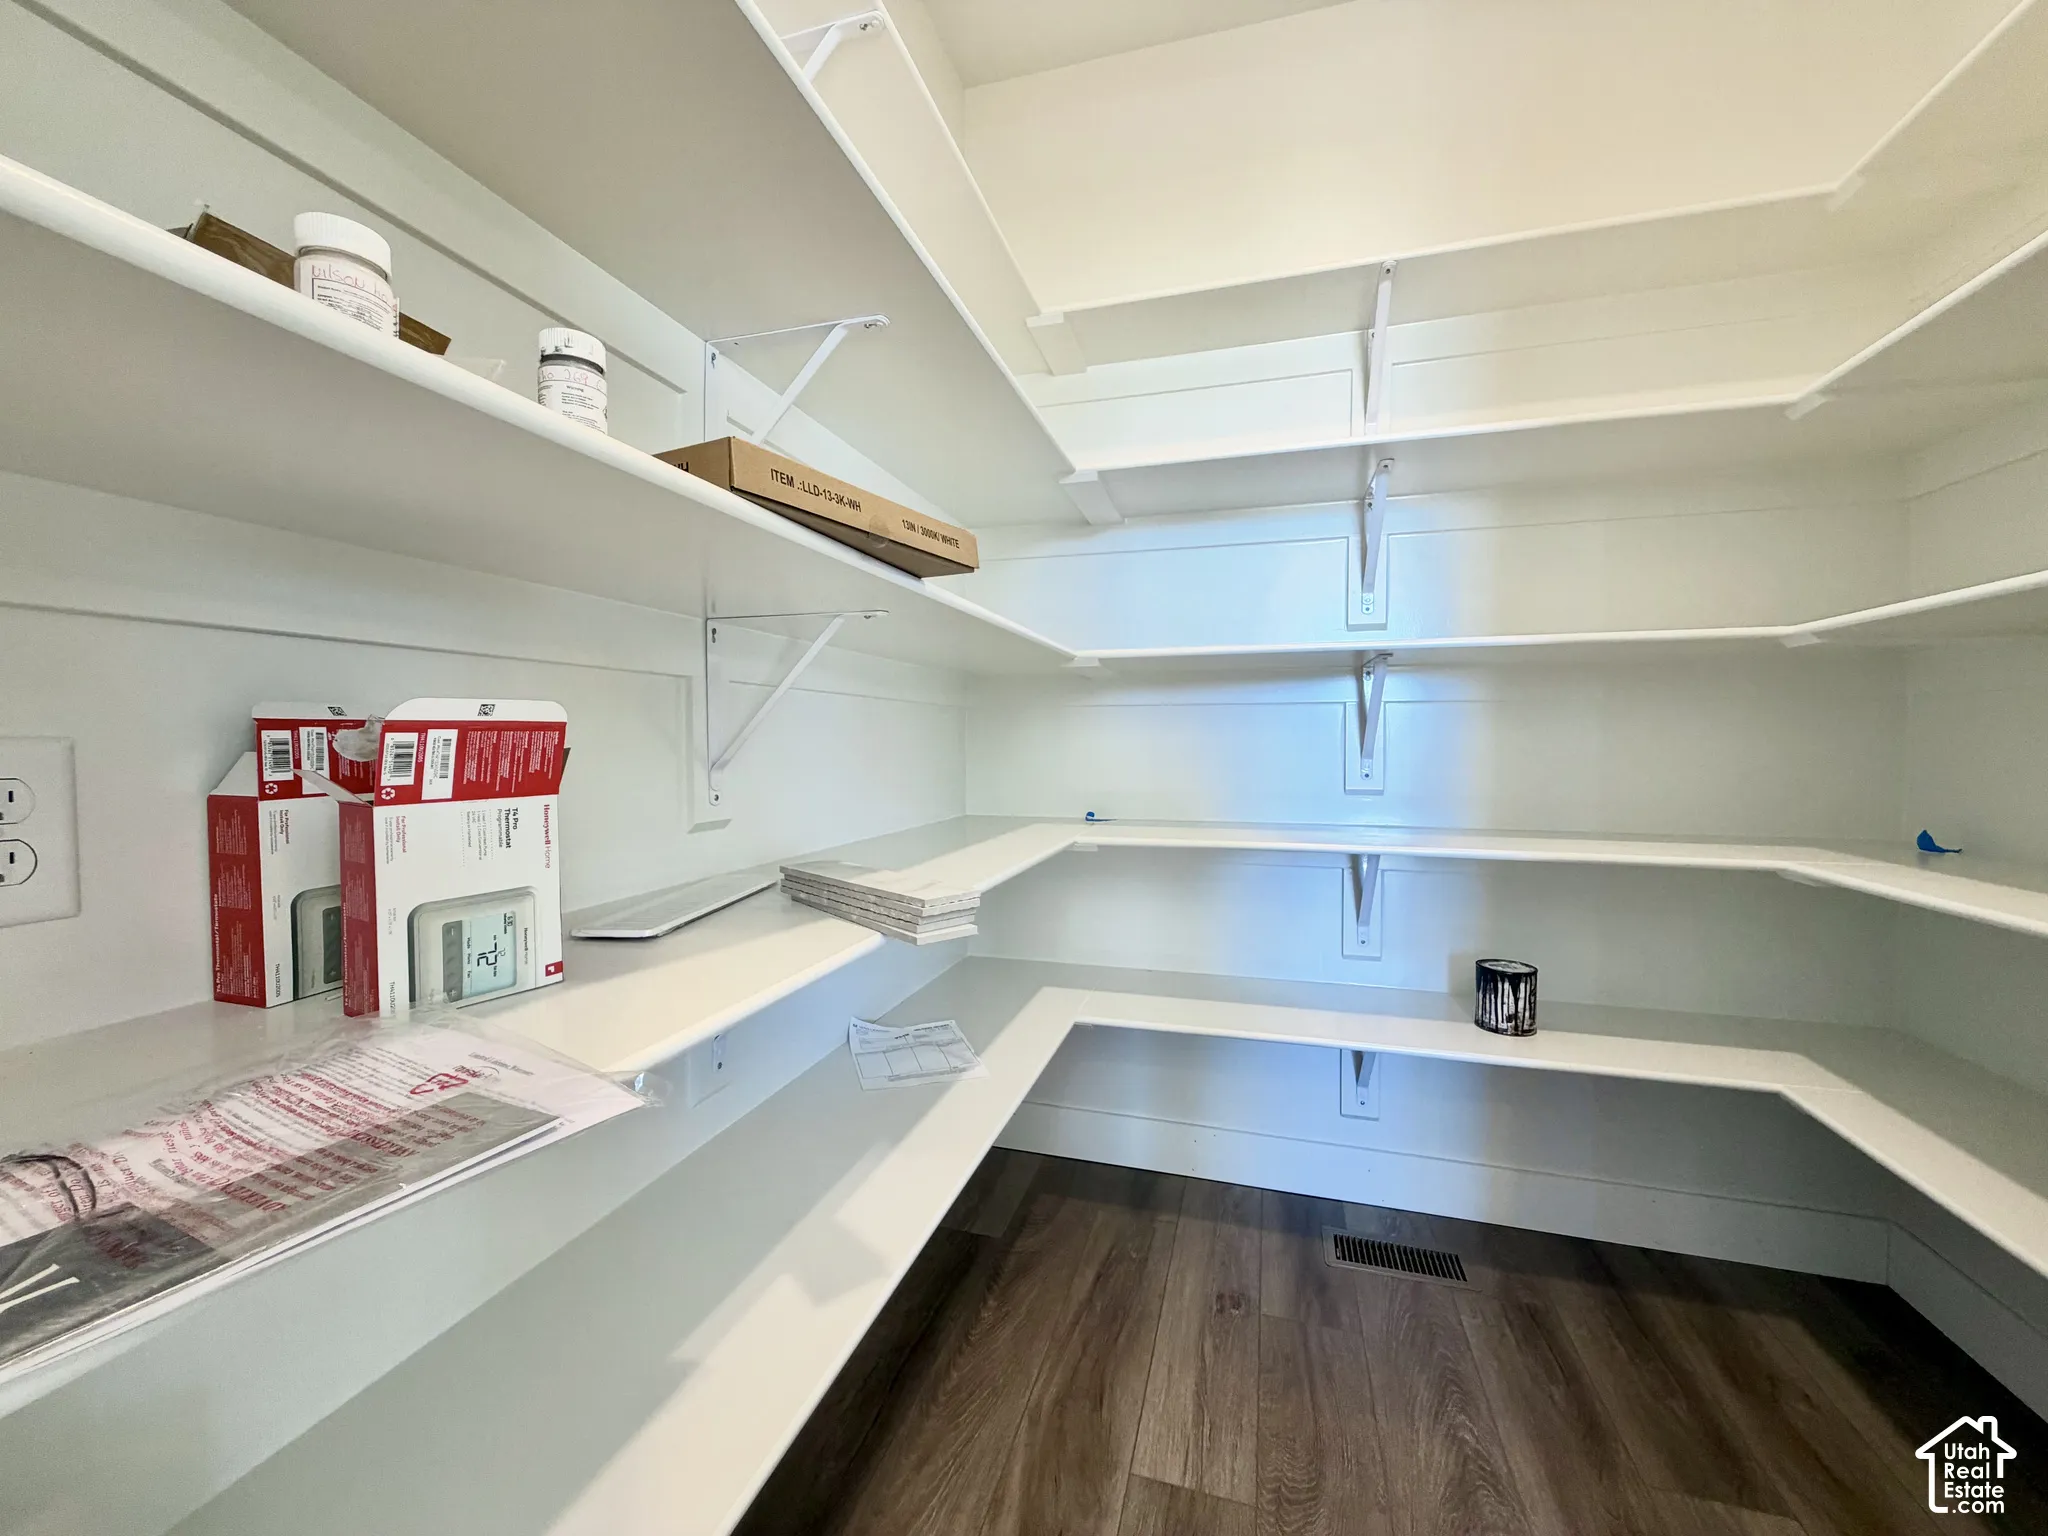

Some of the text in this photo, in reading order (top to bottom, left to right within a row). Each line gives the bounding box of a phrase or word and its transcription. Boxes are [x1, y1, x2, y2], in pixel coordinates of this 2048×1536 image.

[770, 468, 795, 488] ITEM
[901, 519, 916, 533] 13IN
[940, 533, 960, 549] WHITE
[512, 807, 519, 817] T4
[496, 808, 504, 848] Programmable
[504, 808, 512, 849] Thermostat
[543, 804, 552, 869] Honeywell Home
[477, 941, 497, 967] 72
